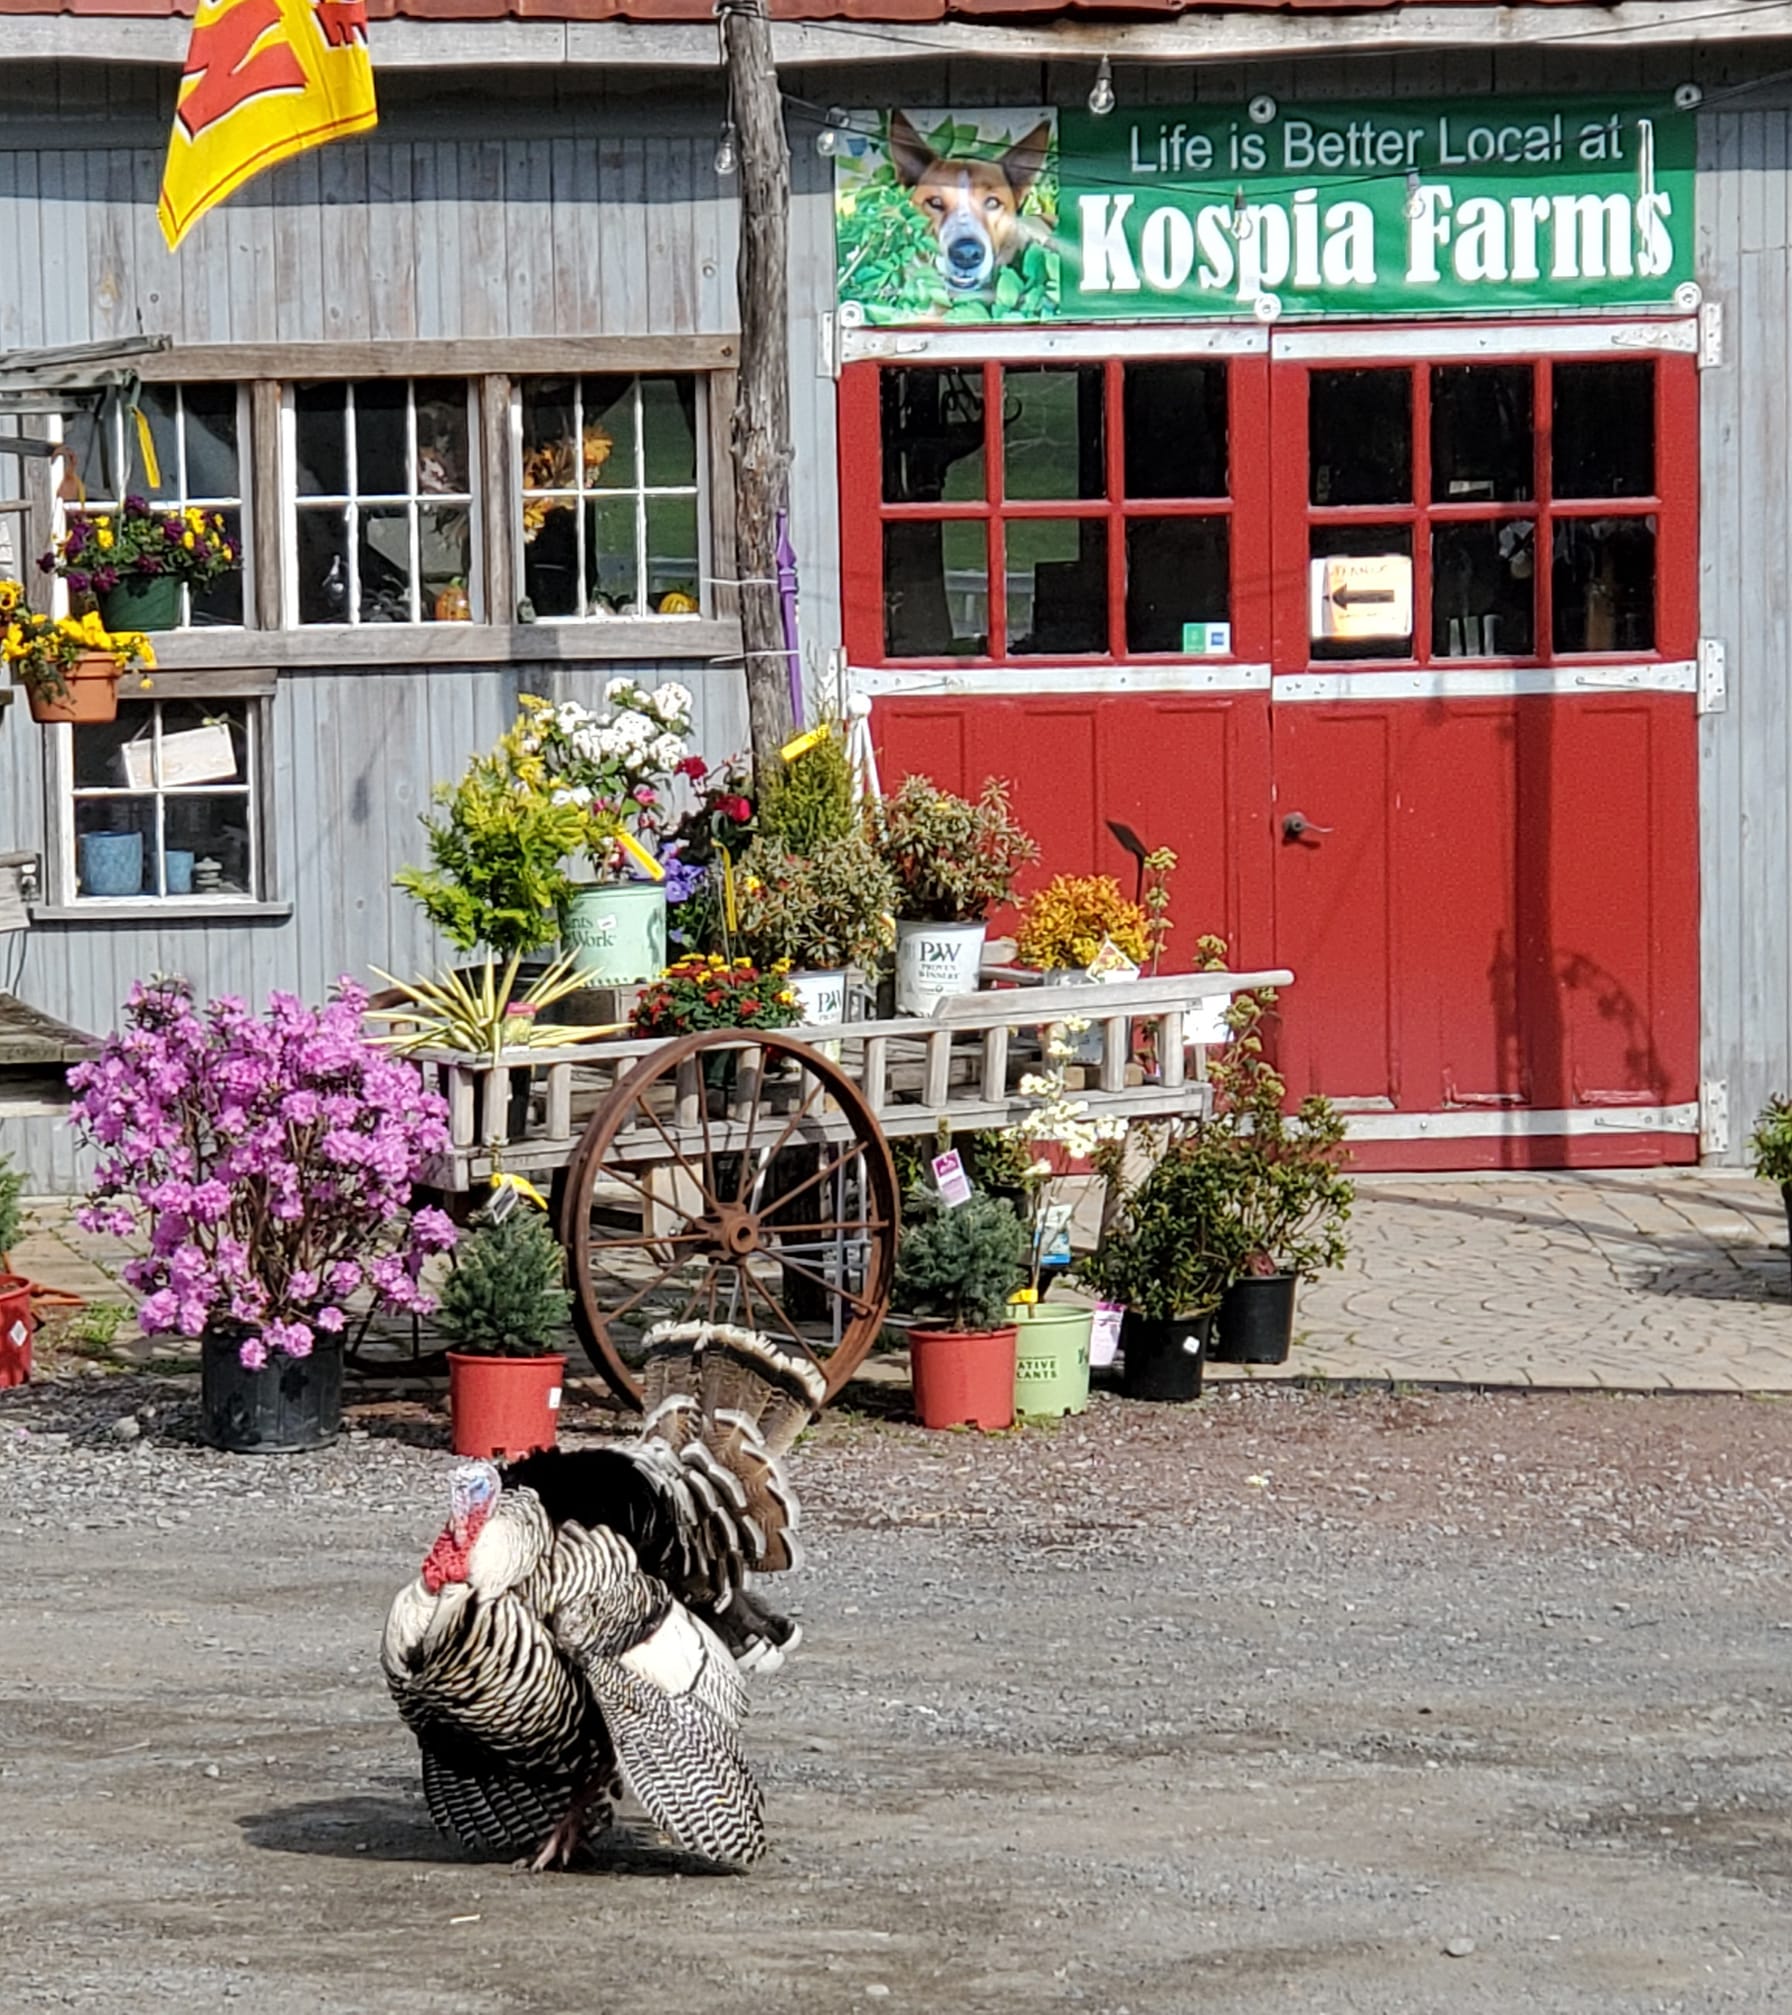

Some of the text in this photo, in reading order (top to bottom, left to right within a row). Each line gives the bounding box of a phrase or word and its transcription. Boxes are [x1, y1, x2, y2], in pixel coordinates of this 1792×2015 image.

[1130, 113, 1624, 173] Life is Better Local at
[1078, 184, 1674, 302] Kospia Farms
[1016, 1370, 1058, 1379] LANTS
[1018, 1360, 1056, 1370] ATIVE
